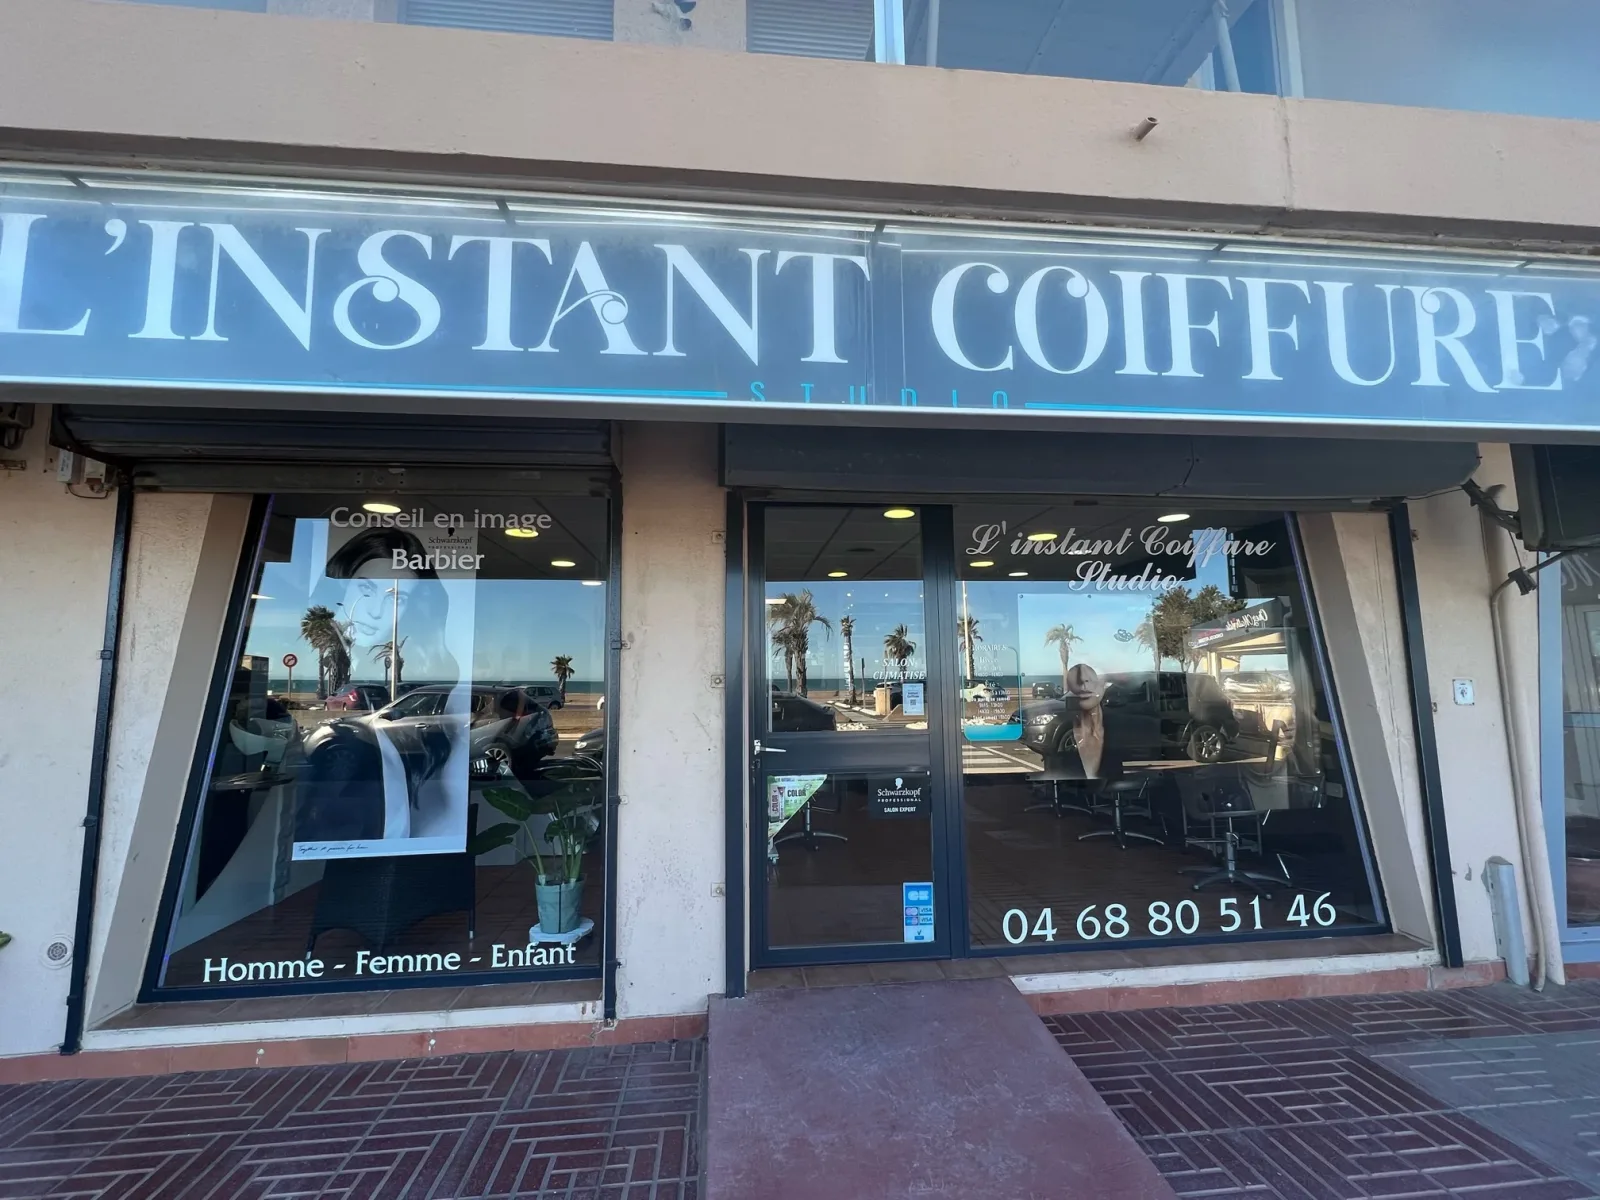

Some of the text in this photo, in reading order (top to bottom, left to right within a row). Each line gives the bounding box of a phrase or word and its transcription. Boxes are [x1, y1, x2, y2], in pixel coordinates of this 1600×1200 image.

[0, 213, 1563, 393] L'INSTANT COIFFURE
[750, 381, 1008, 409] STUDIO
[331, 507, 552, 533] Conseil en image
[428, 536, 473, 545] Schwarzkopf
[966, 520, 1132, 556] L'instant
[1139, 525, 1276, 568] Coiffure
[391, 548, 485, 570] Barbier
[1068, 560, 1184, 591] Studio
[882, 658, 915, 667] SALON
[878, 788, 921, 798] Schwarzkopf
[1002, 892, 1336, 944] 04 68 80 51 46
[203, 957, 323, 983] Homme
[355, 950, 461, 975] Femme
[491, 943, 576, 968] Enfant
